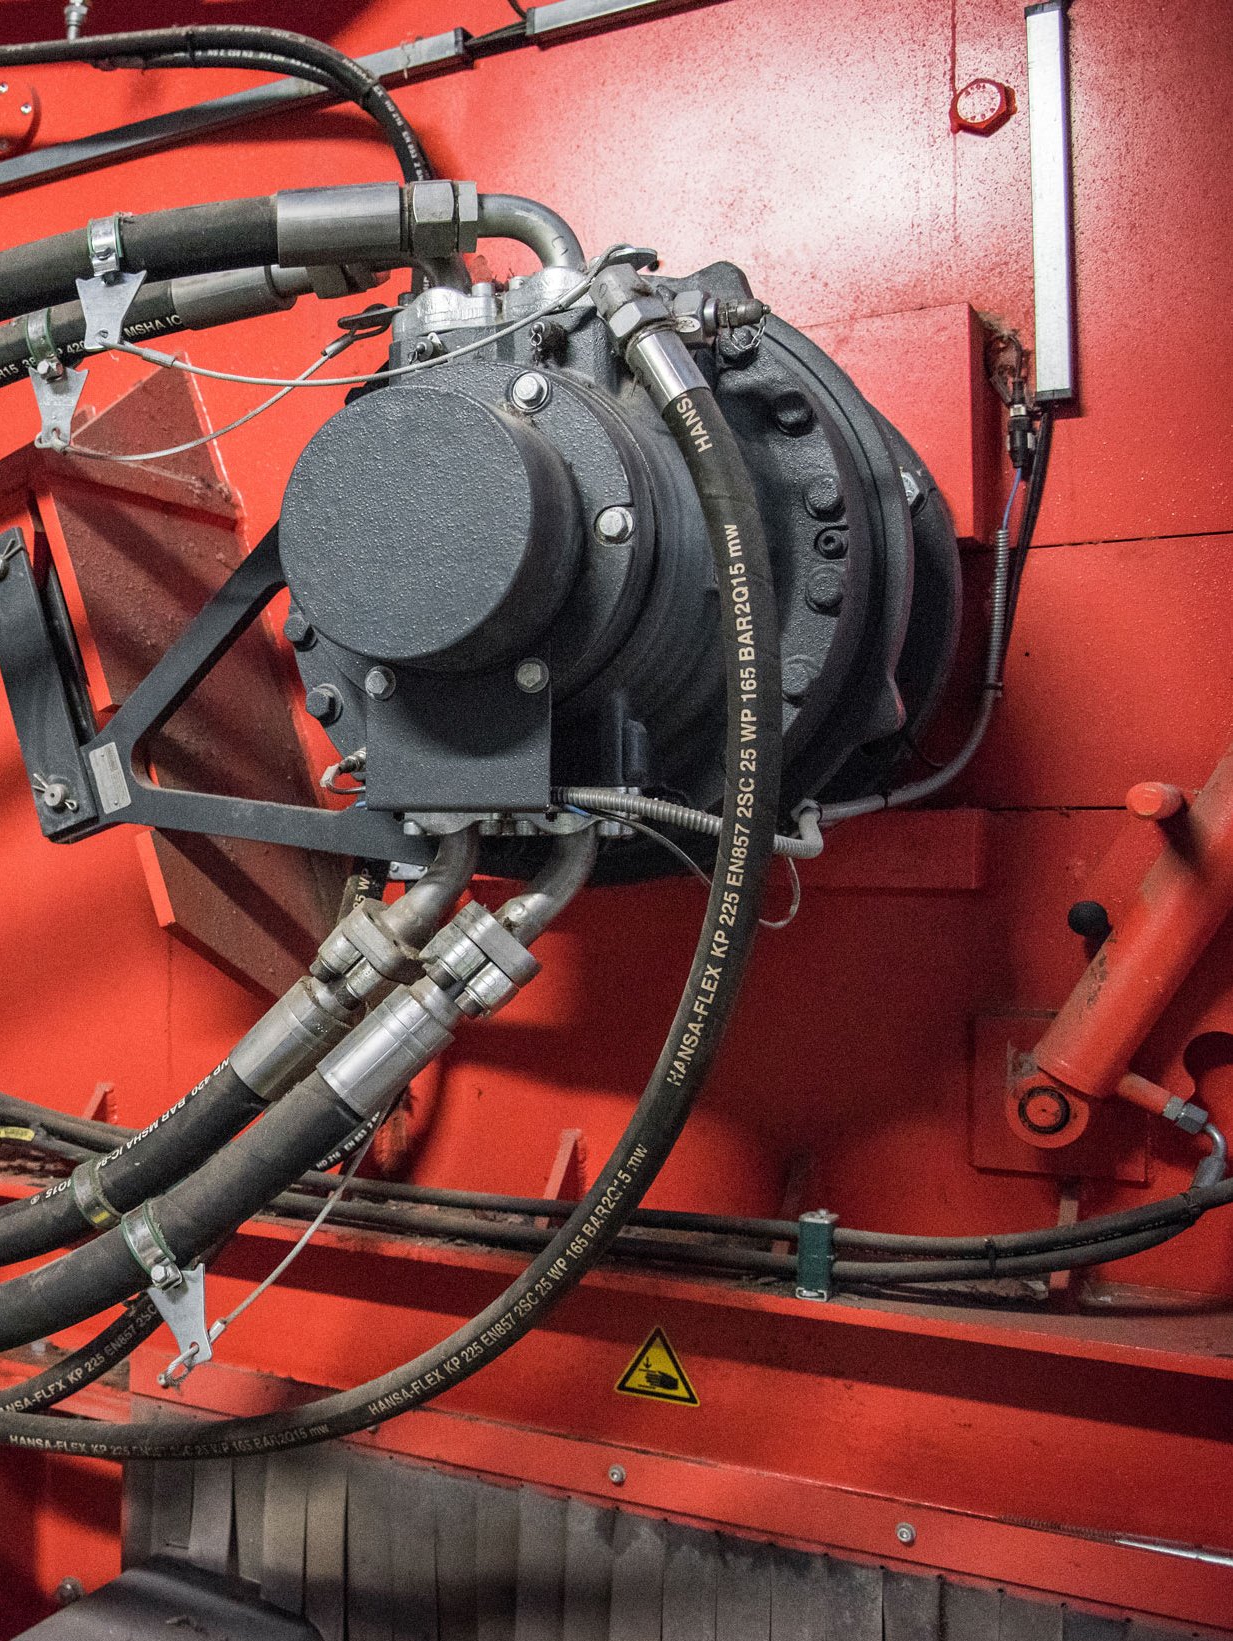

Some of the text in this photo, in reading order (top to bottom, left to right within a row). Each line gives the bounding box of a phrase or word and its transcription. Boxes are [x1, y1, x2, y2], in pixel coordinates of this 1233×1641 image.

[123, 319, 166, 339] MSHA
[676, 393, 713, 453] HANS
[667, 524, 757, 1086] HANSA-FLEX KP 225 EN857 2SC 25 WP 165 BAR2Q15 mw
[357, 867, 373, 890] WP
[191, 1071, 215, 1097] 420
[161, 1097, 187, 1124] BAR
[126, 1118, 168, 1150] MSHA
[368, 1369, 446, 1417] HANSA-FLEX
[444, 1356, 464, 1375] KP
[460, 1341, 485, 1365] 225
[480, 1312, 518, 1348] EN857
[513, 1291, 540, 1320] 2SC
[533, 1276, 554, 1300] 25
[546, 1257, 569, 1282] WP
[564, 1236, 589, 1262] 165
[625, 1142, 649, 1172] mw
[67, 1366, 85, 1384] KP
[84, 1353, 106, 1372] 225
[104, 1326, 138, 1356] EN857
[9, 1434, 86, 1452] HANSA-FLEX
[308, 1423, 330, 1438] mw
